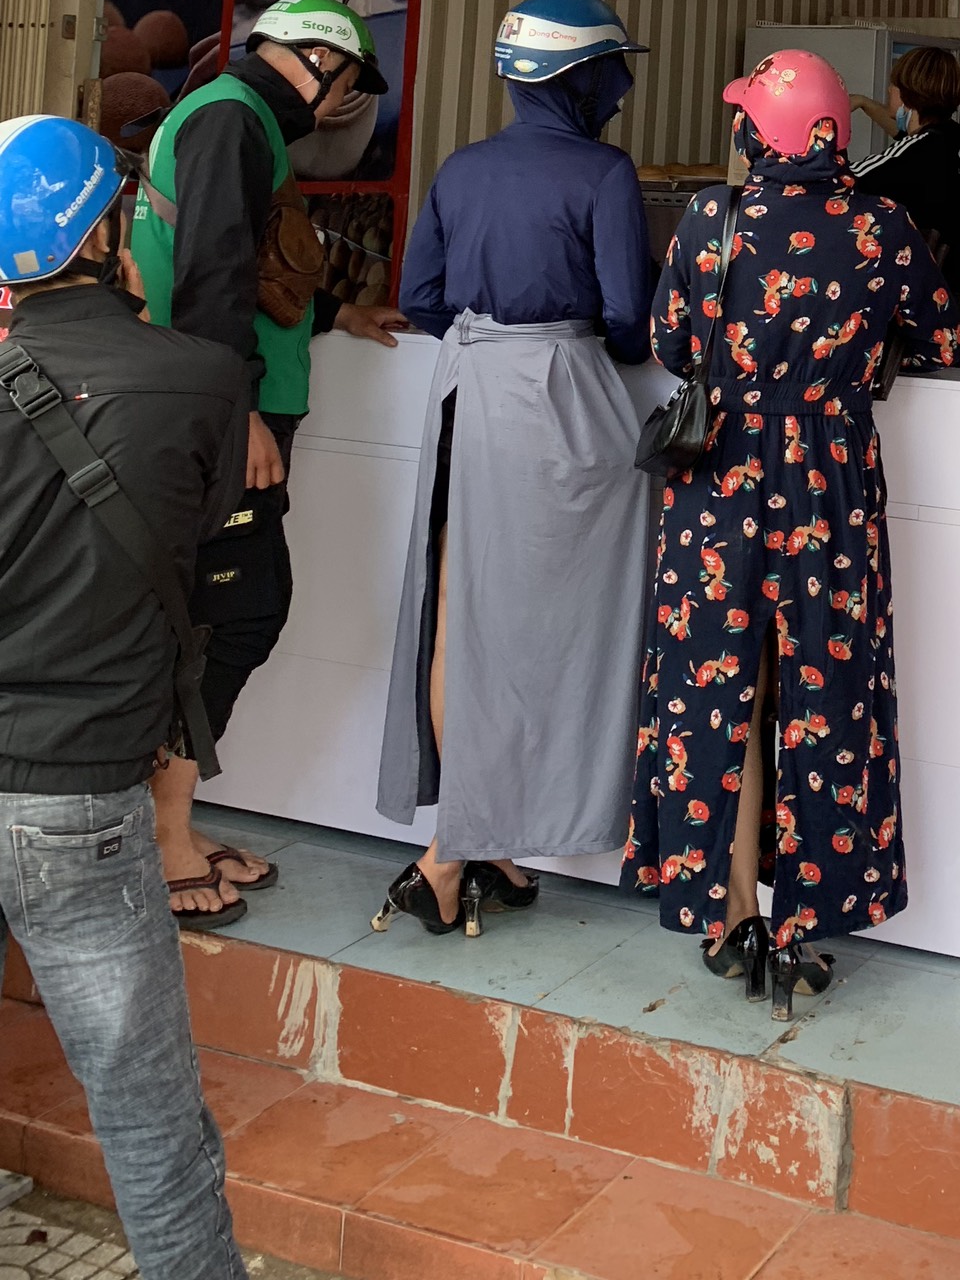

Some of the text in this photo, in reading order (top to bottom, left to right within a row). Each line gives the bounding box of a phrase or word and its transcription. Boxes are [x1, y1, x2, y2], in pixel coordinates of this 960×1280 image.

[301, 20, 333, 34] Stop
[55, 163, 104, 228] Sacombank
[103, 843, 119, 855] DG
